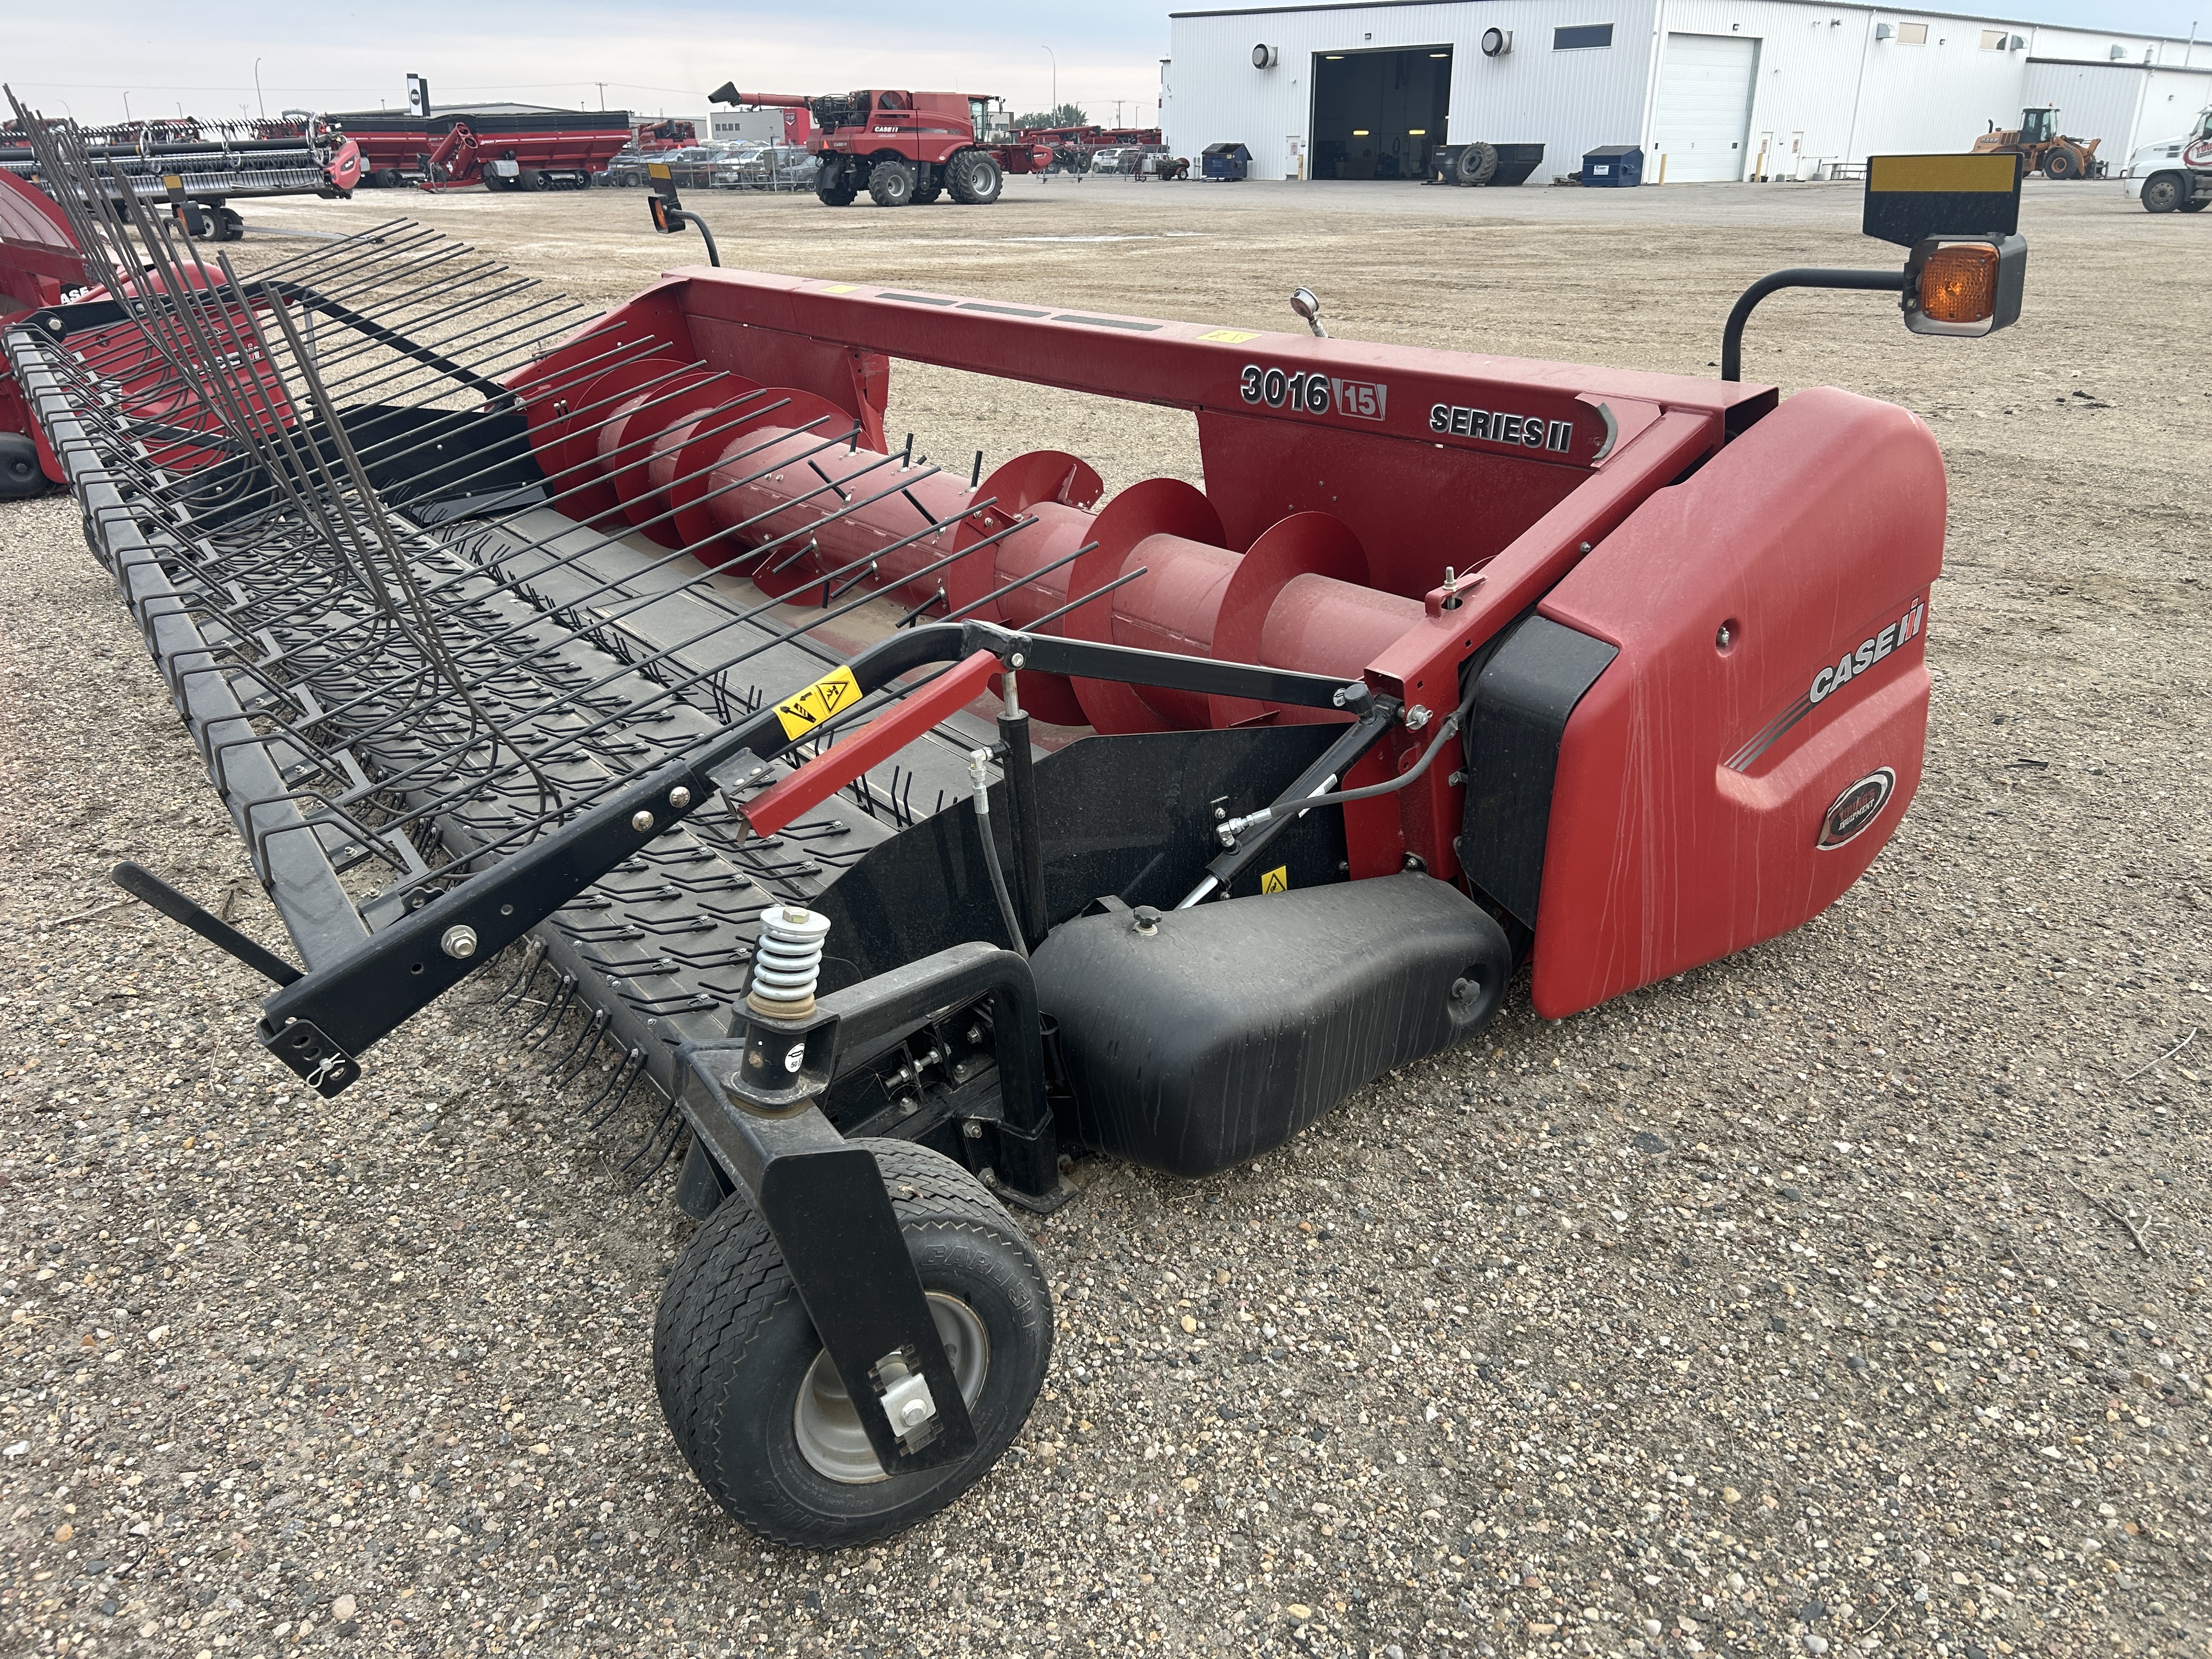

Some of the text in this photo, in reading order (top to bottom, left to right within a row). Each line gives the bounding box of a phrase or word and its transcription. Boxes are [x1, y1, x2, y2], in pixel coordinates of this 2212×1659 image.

[60, 286, 89, 304] ASE
[1240, 364, 1376, 415] 3016 15
[1430, 403, 1573, 453] SERIES II
[1810, 622, 1897, 703] CASE
[1838, 788, 1875, 822] YOUNG'S
[1838, 799, 1875, 831] EQUIPMENT
[919, 1244, 1037, 1345] CARLISLE
